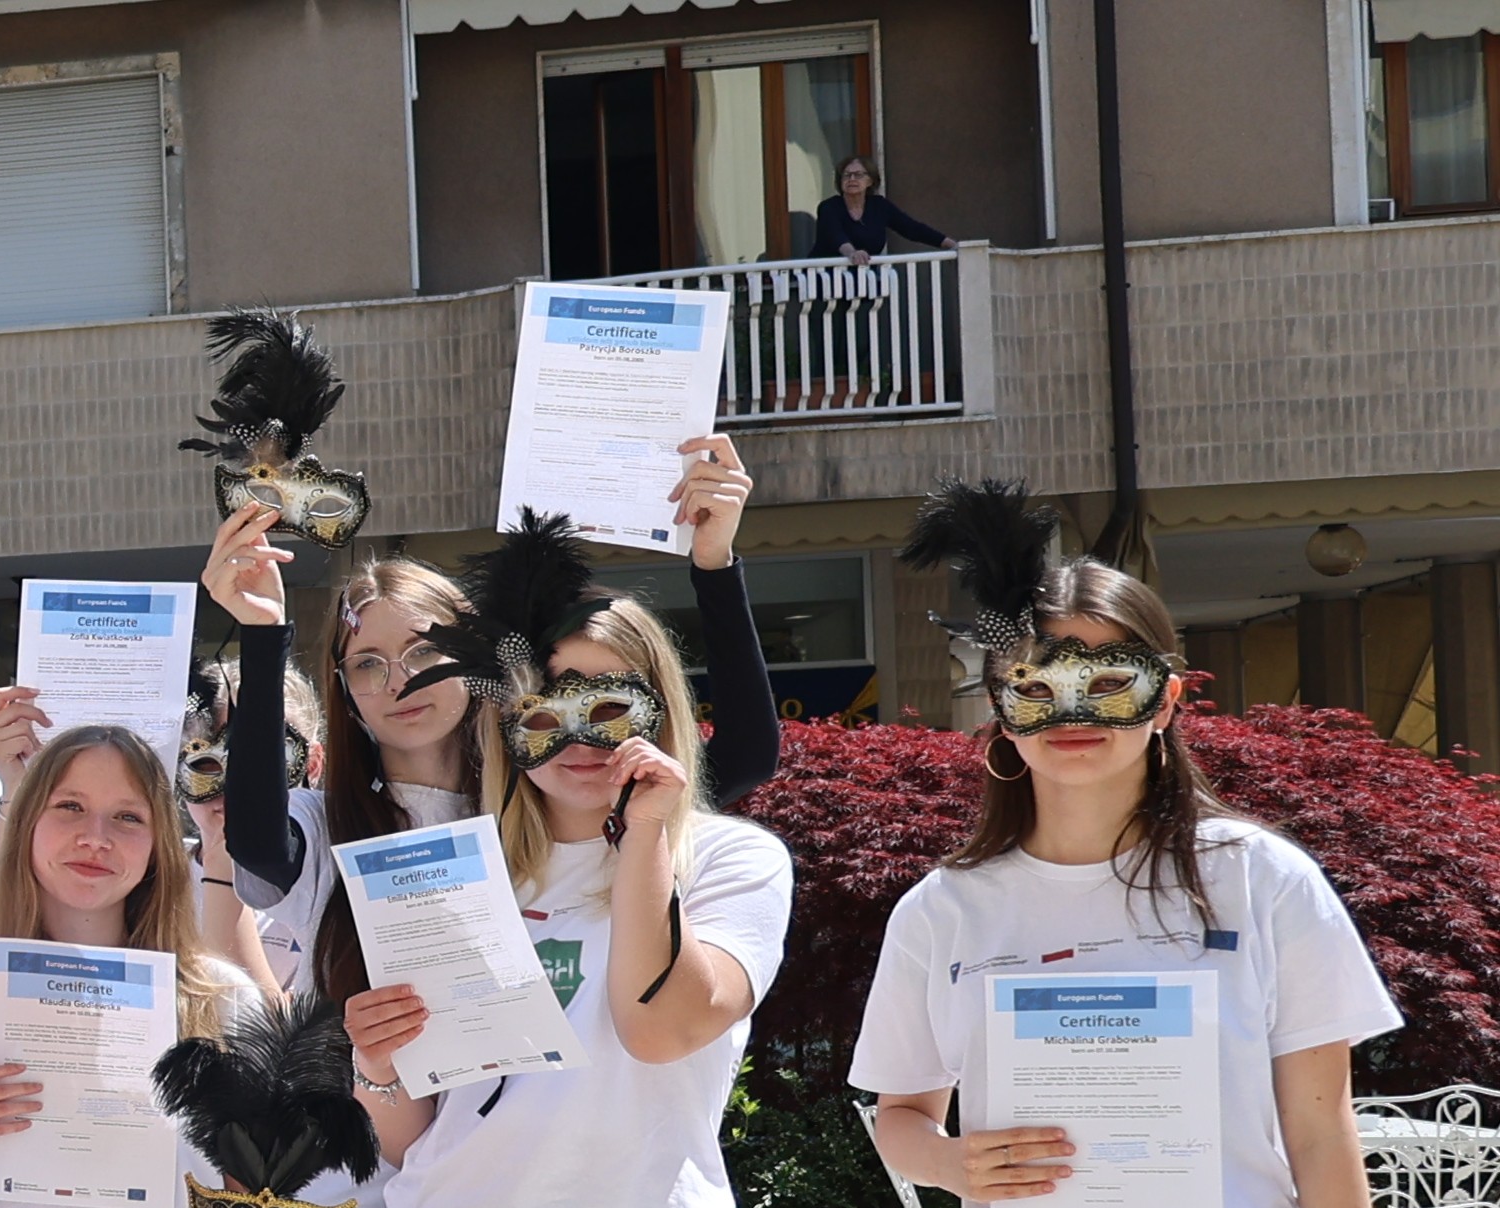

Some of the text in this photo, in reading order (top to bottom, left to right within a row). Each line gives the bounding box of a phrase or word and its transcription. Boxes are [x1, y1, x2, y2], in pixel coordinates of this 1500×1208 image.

[588, 306, 622, 315] European
[587, 325, 657, 340] Certificate
[579, 343, 661, 355] Patrycja Boroszko
[78, 617, 138, 628] Certificate
[386, 850, 431, 862] European Funds
[392, 867, 449, 886] Certificate
[387, 892, 408, 903] Emilia
[46, 961, 99, 972] European Funds
[47, 980, 113, 995] Certificate
[39, 997, 71, 1006] Klaudia
[1057, 994, 1096, 1002] European
[1060, 1016, 1140, 1027] Certificate
[1044, 1035, 1157, 1045] Michalina Grabowska
